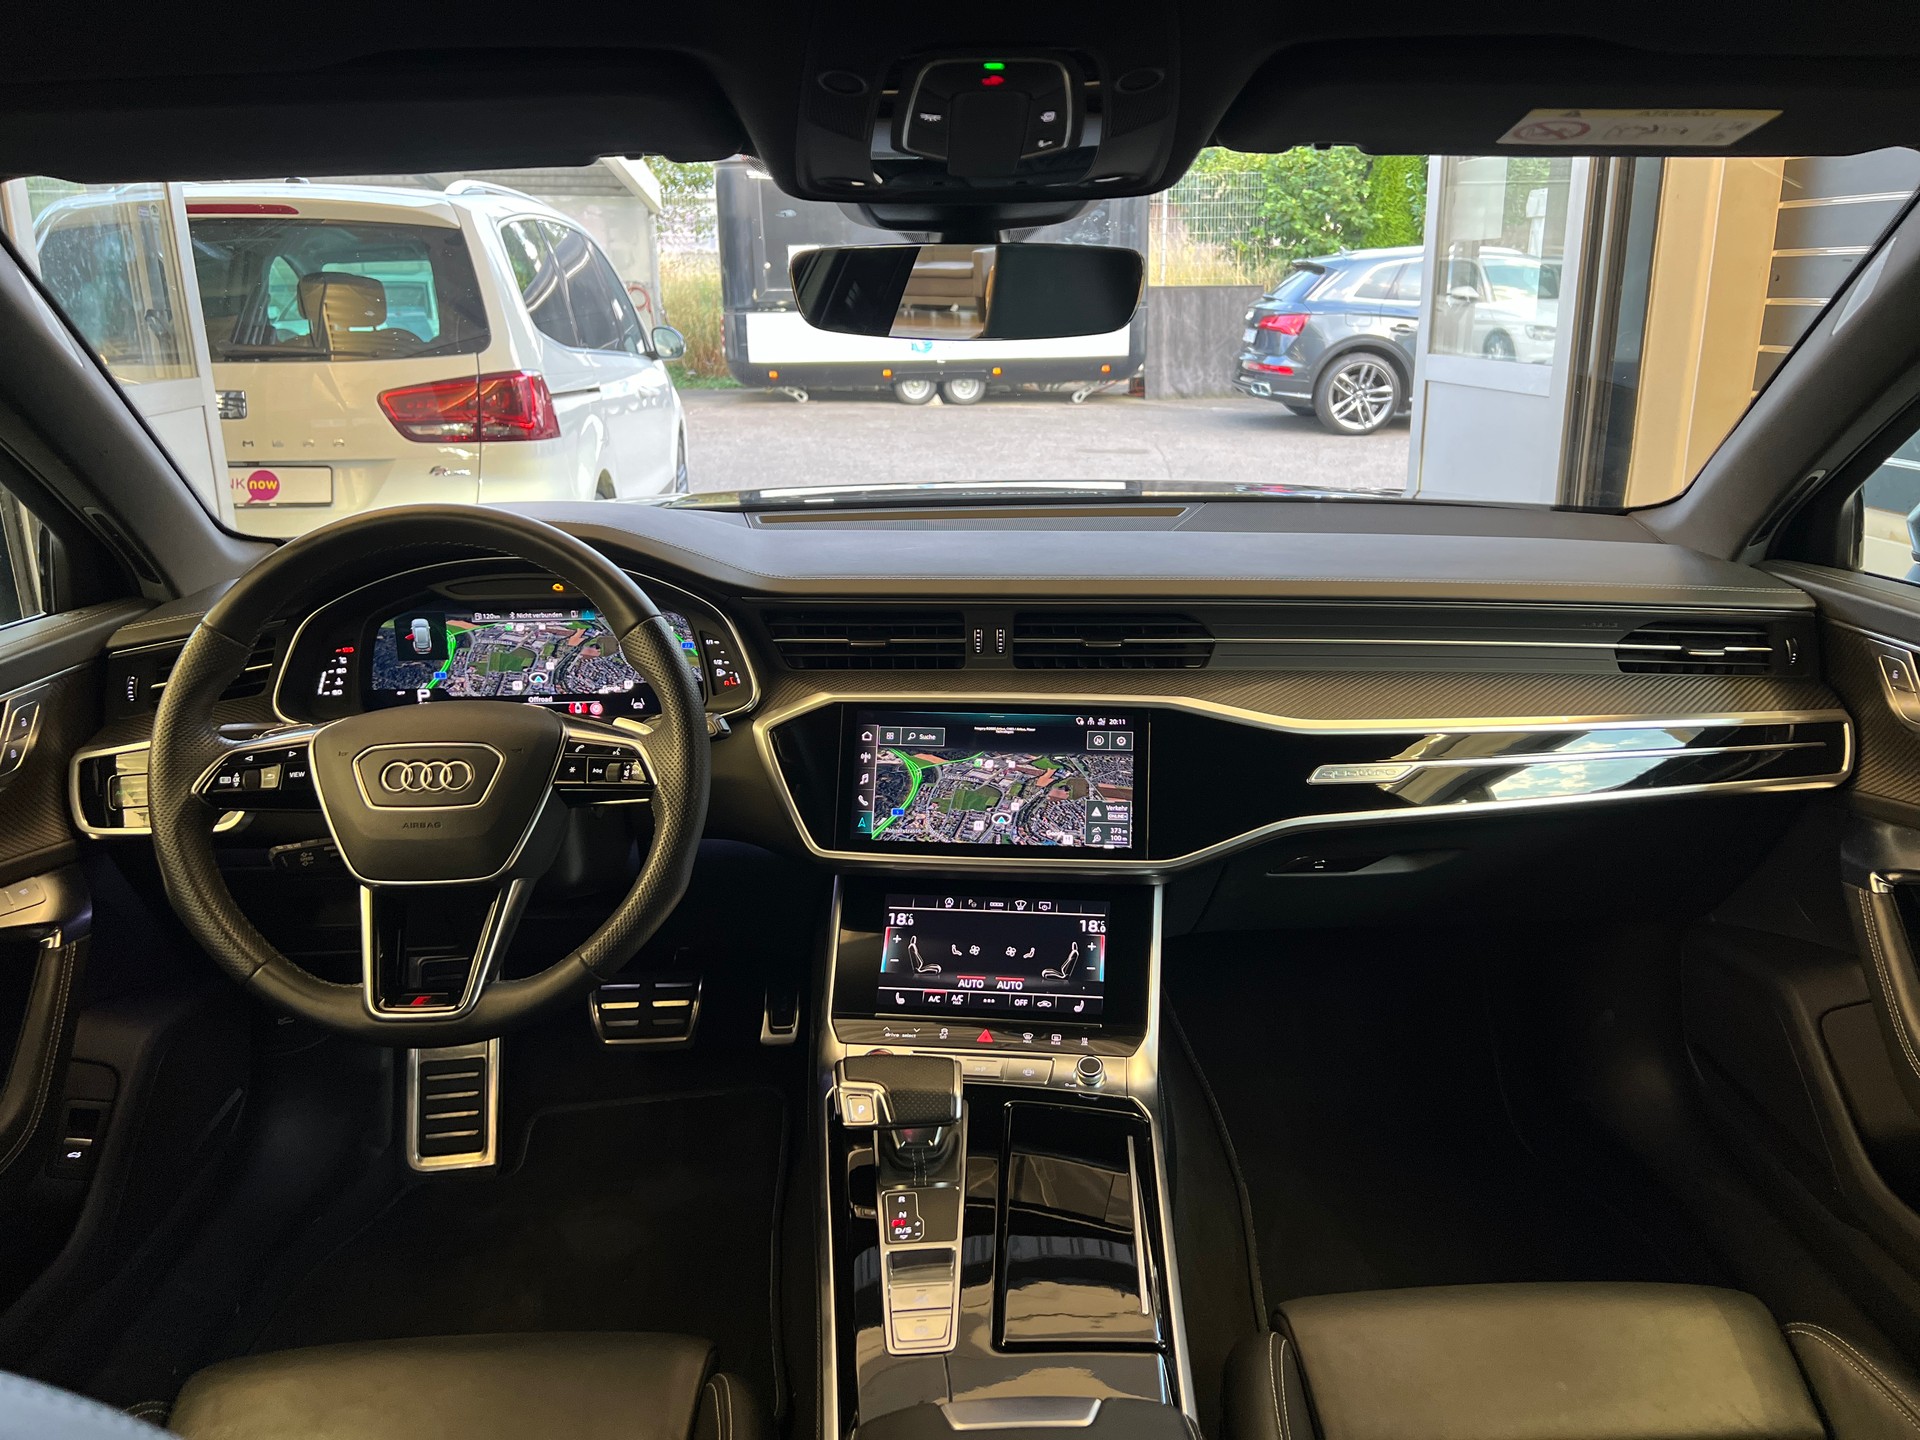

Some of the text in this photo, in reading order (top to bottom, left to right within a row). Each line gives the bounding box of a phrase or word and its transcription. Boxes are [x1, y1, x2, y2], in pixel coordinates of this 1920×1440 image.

[249, 480, 277, 490] now
[416, 688, 431, 702] P
[1108, 718, 1126, 726] 20:11
[919, 733, 937, 741] Suche
[1321, 768, 1397, 779] quattro
[1105, 804, 1129, 812] Verkehr
[402, 821, 442, 829] AIRBAG
[957, 979, 985, 989] AUTO
[996, 981, 1024, 991] AUTO
[928, 995, 941, 1003] A/C
[951, 994, 964, 1002] A/C
[1014, 998, 1029, 1007] OFF
[858, 1104, 865, 1114] P
[898, 1211, 907, 1219] N
[894, 1226, 912, 1235] D/S
